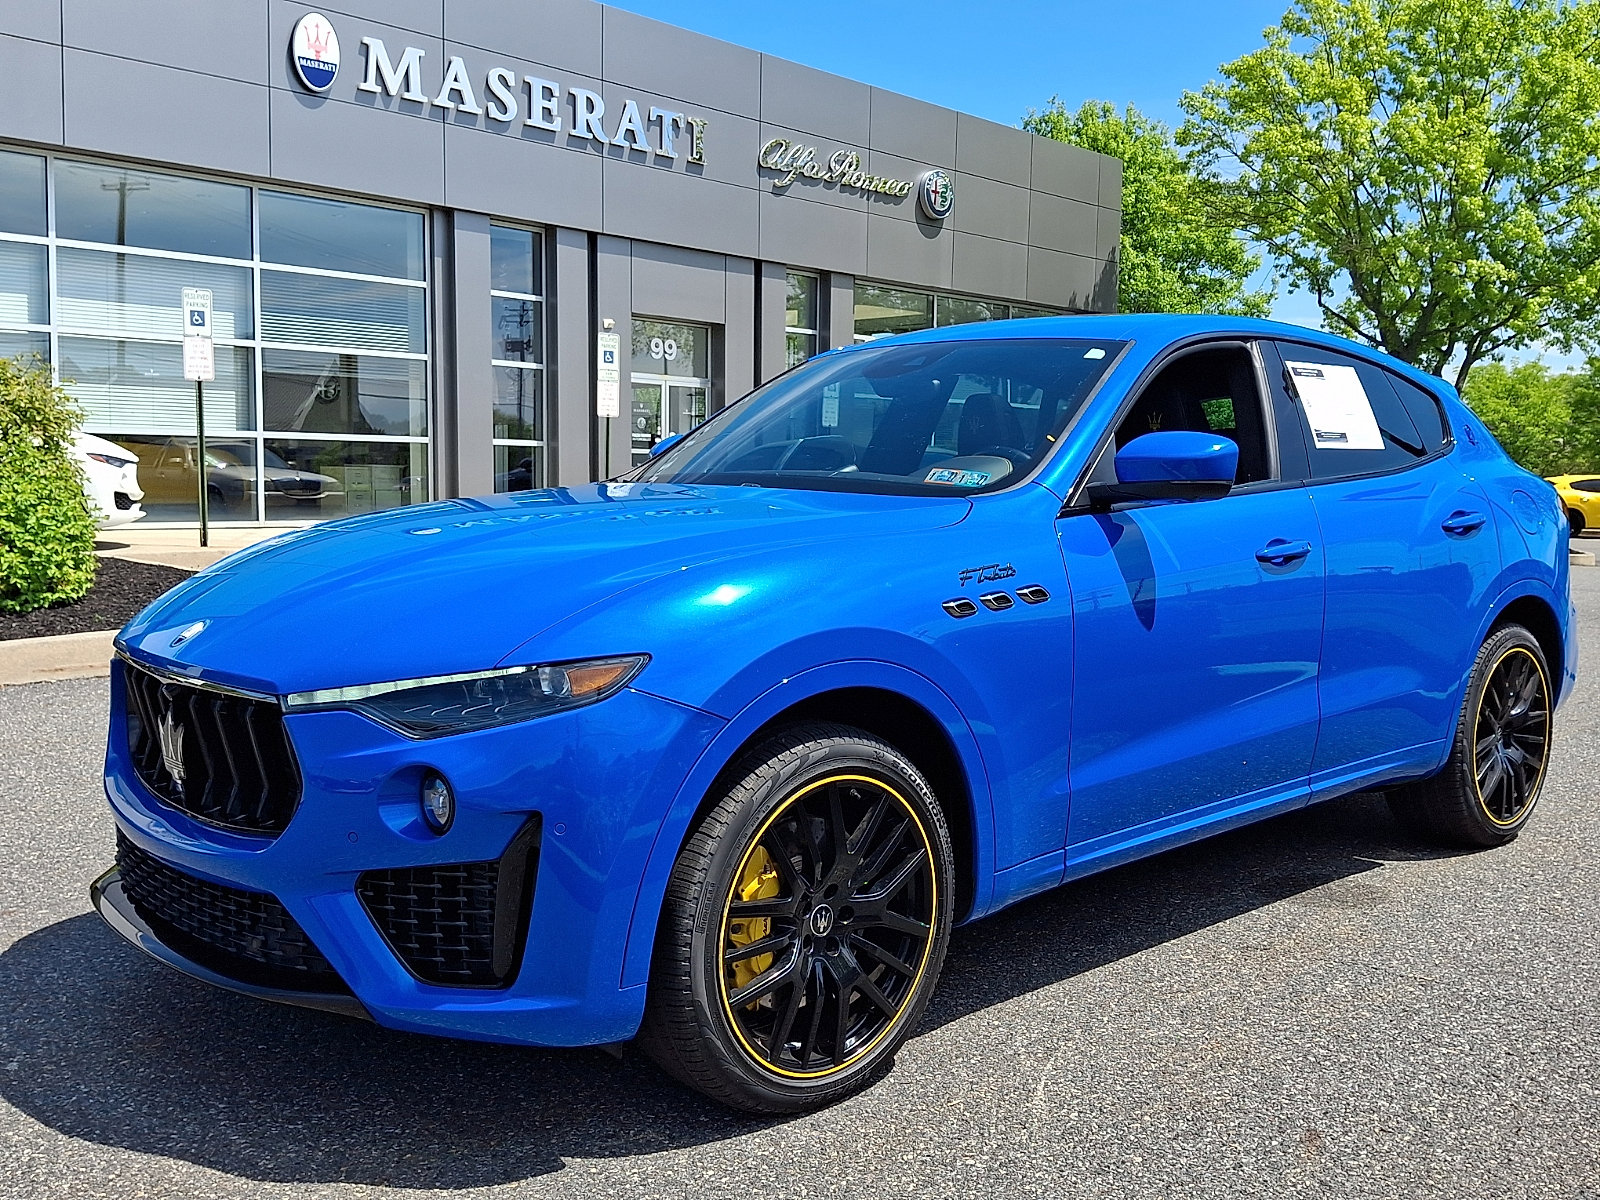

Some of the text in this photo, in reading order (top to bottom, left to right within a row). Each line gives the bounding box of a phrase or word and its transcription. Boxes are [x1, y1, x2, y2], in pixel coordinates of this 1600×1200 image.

[300, 58, 336, 72] MASERATI
[356, 36, 708, 165] MASERATI
[758, 138, 824, 187] Alfa
[828, 150, 914, 196] Romeo
[651, 338, 677, 360] 99
[890, 759, 945, 831] SCORPION
